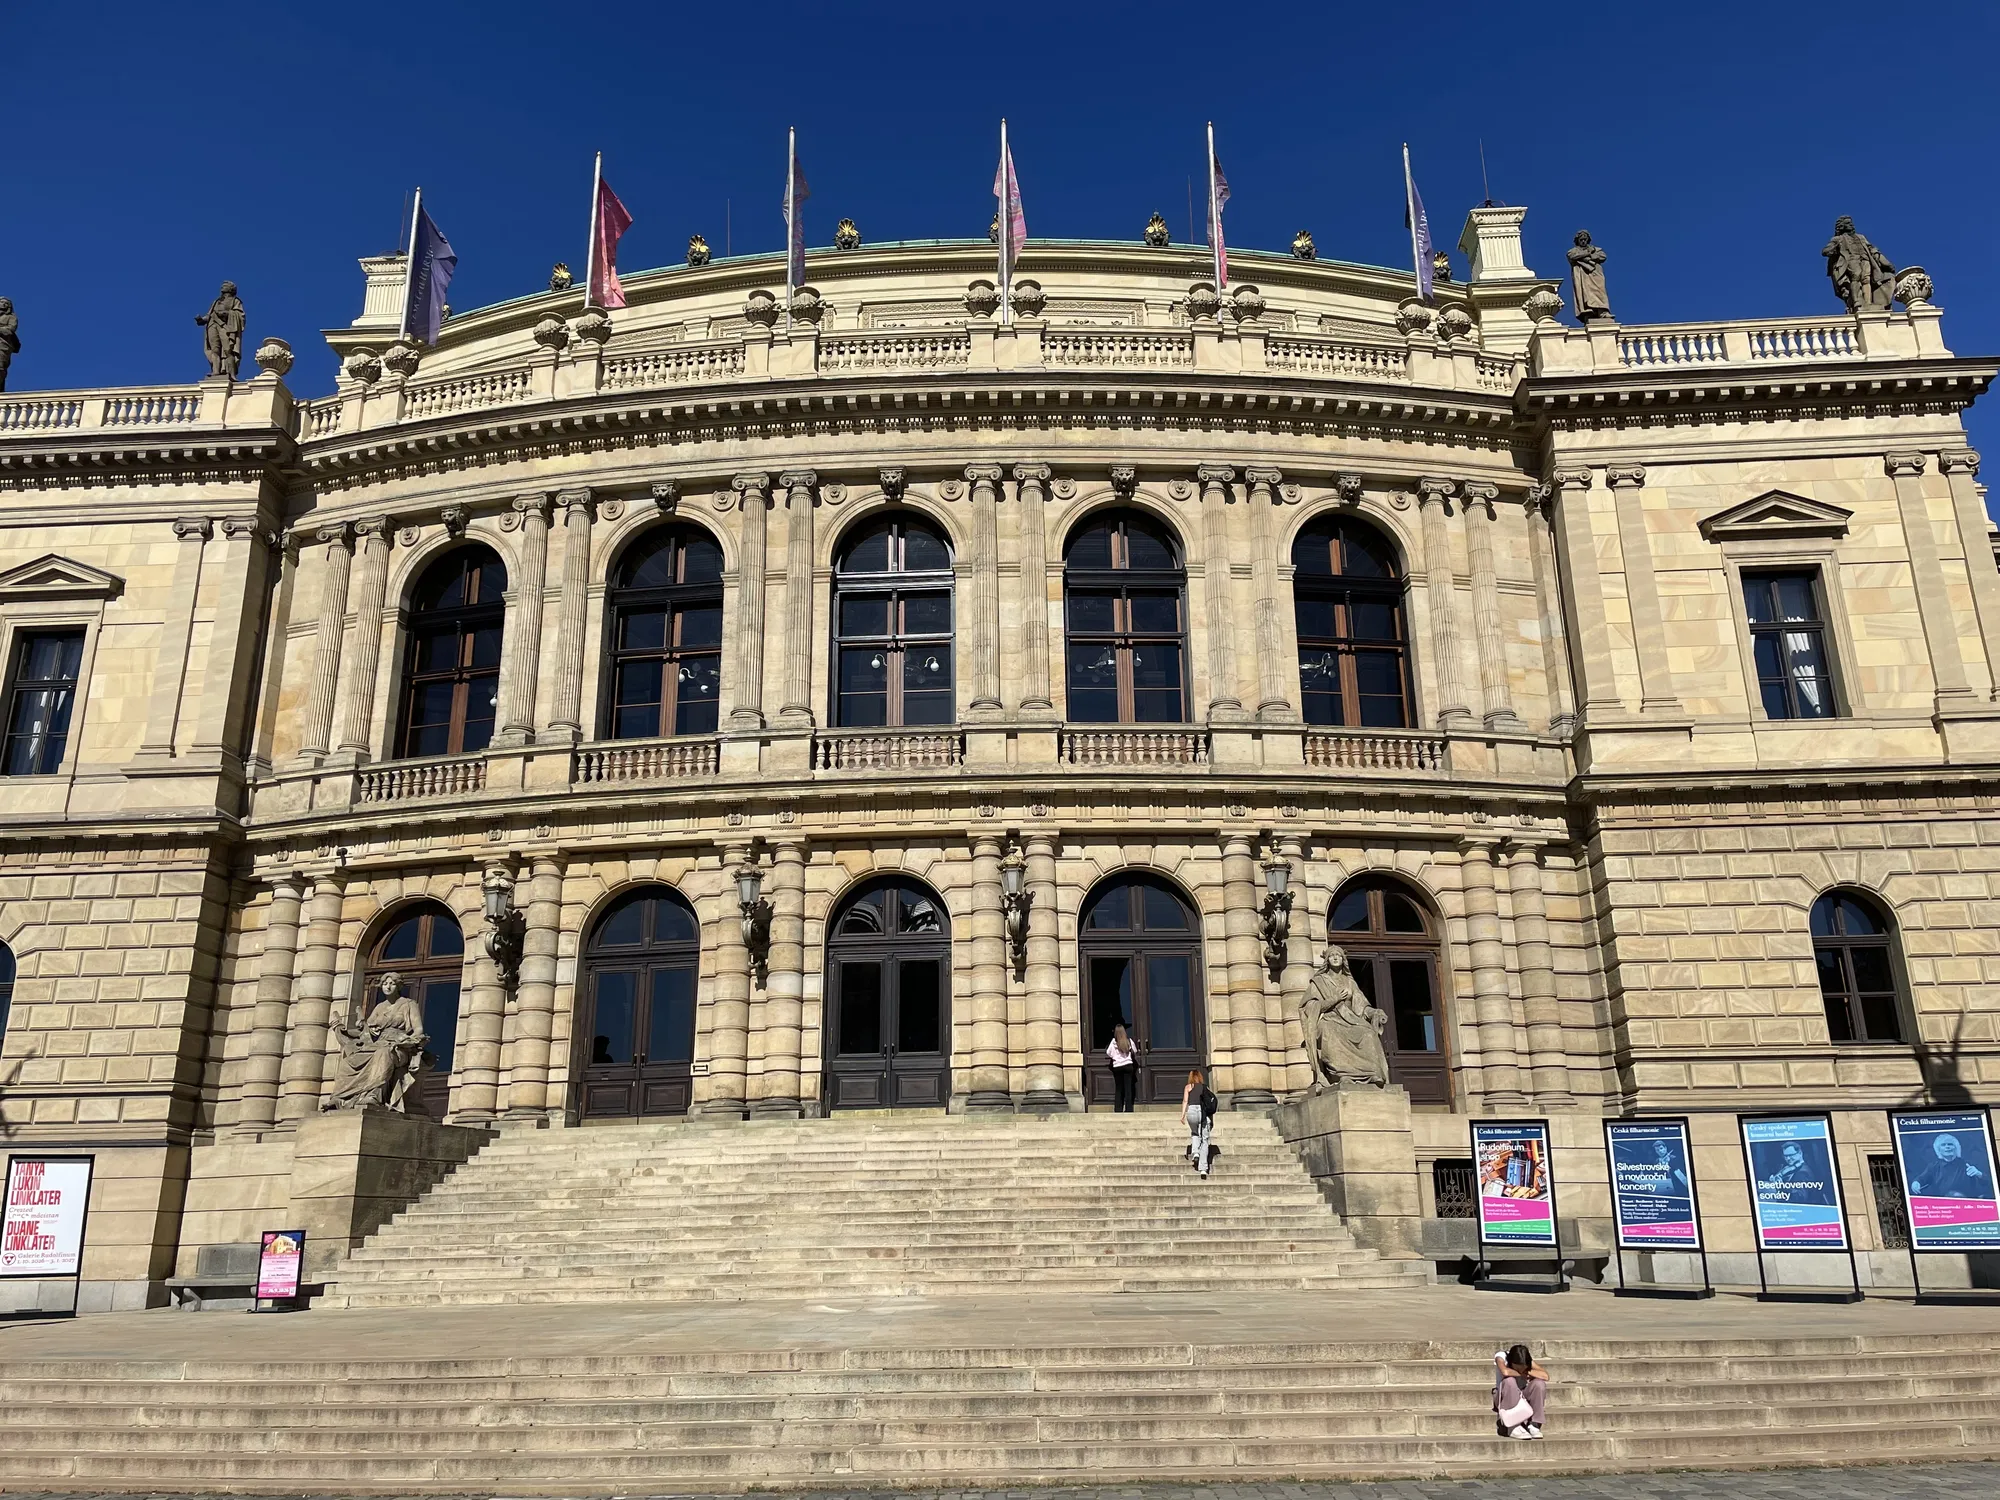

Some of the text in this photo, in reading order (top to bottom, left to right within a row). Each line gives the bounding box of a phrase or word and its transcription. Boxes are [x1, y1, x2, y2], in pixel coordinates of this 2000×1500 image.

[1480, 1143, 1524, 1151] Rudolfinum
[1481, 1154, 1500, 1162] shop
[15, 1162, 45, 1176] TANYA
[1617, 1163, 1670, 1171] Silvestrovské
[1625, 1172, 1667, 1181] novoroční
[12, 1176, 41, 1190] LUKIN
[1619, 1182, 1656, 1192] koncerty
[1758, 1181, 1824, 1190] Beethovenovy
[10, 1191, 61, 1205] LINKLATER
[1760, 1191, 1791, 1201] sonáty
[7, 1221, 40, 1235] DUANE
[4, 1235, 56, 1250] LINKLATER
